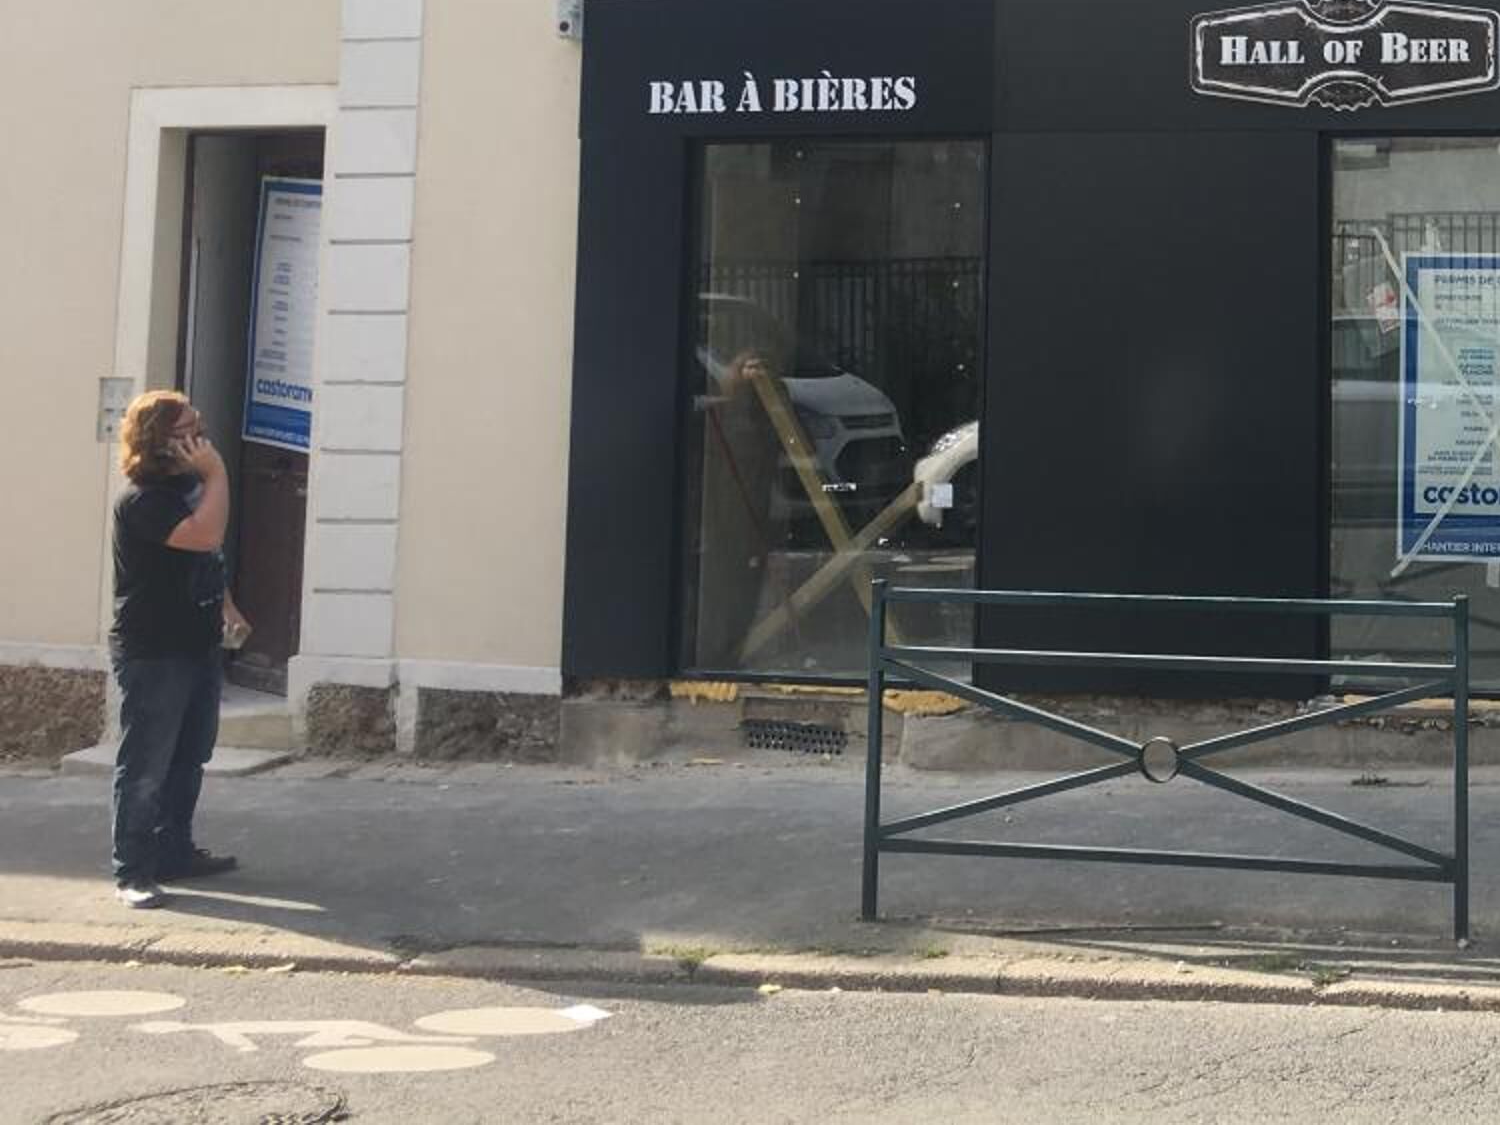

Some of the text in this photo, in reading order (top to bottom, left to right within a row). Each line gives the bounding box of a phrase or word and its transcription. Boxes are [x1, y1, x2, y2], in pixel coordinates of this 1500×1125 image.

[1219, 31, 1471, 65] HALL OF BEER
[648, 70, 917, 114] BAR À BIÈRES
